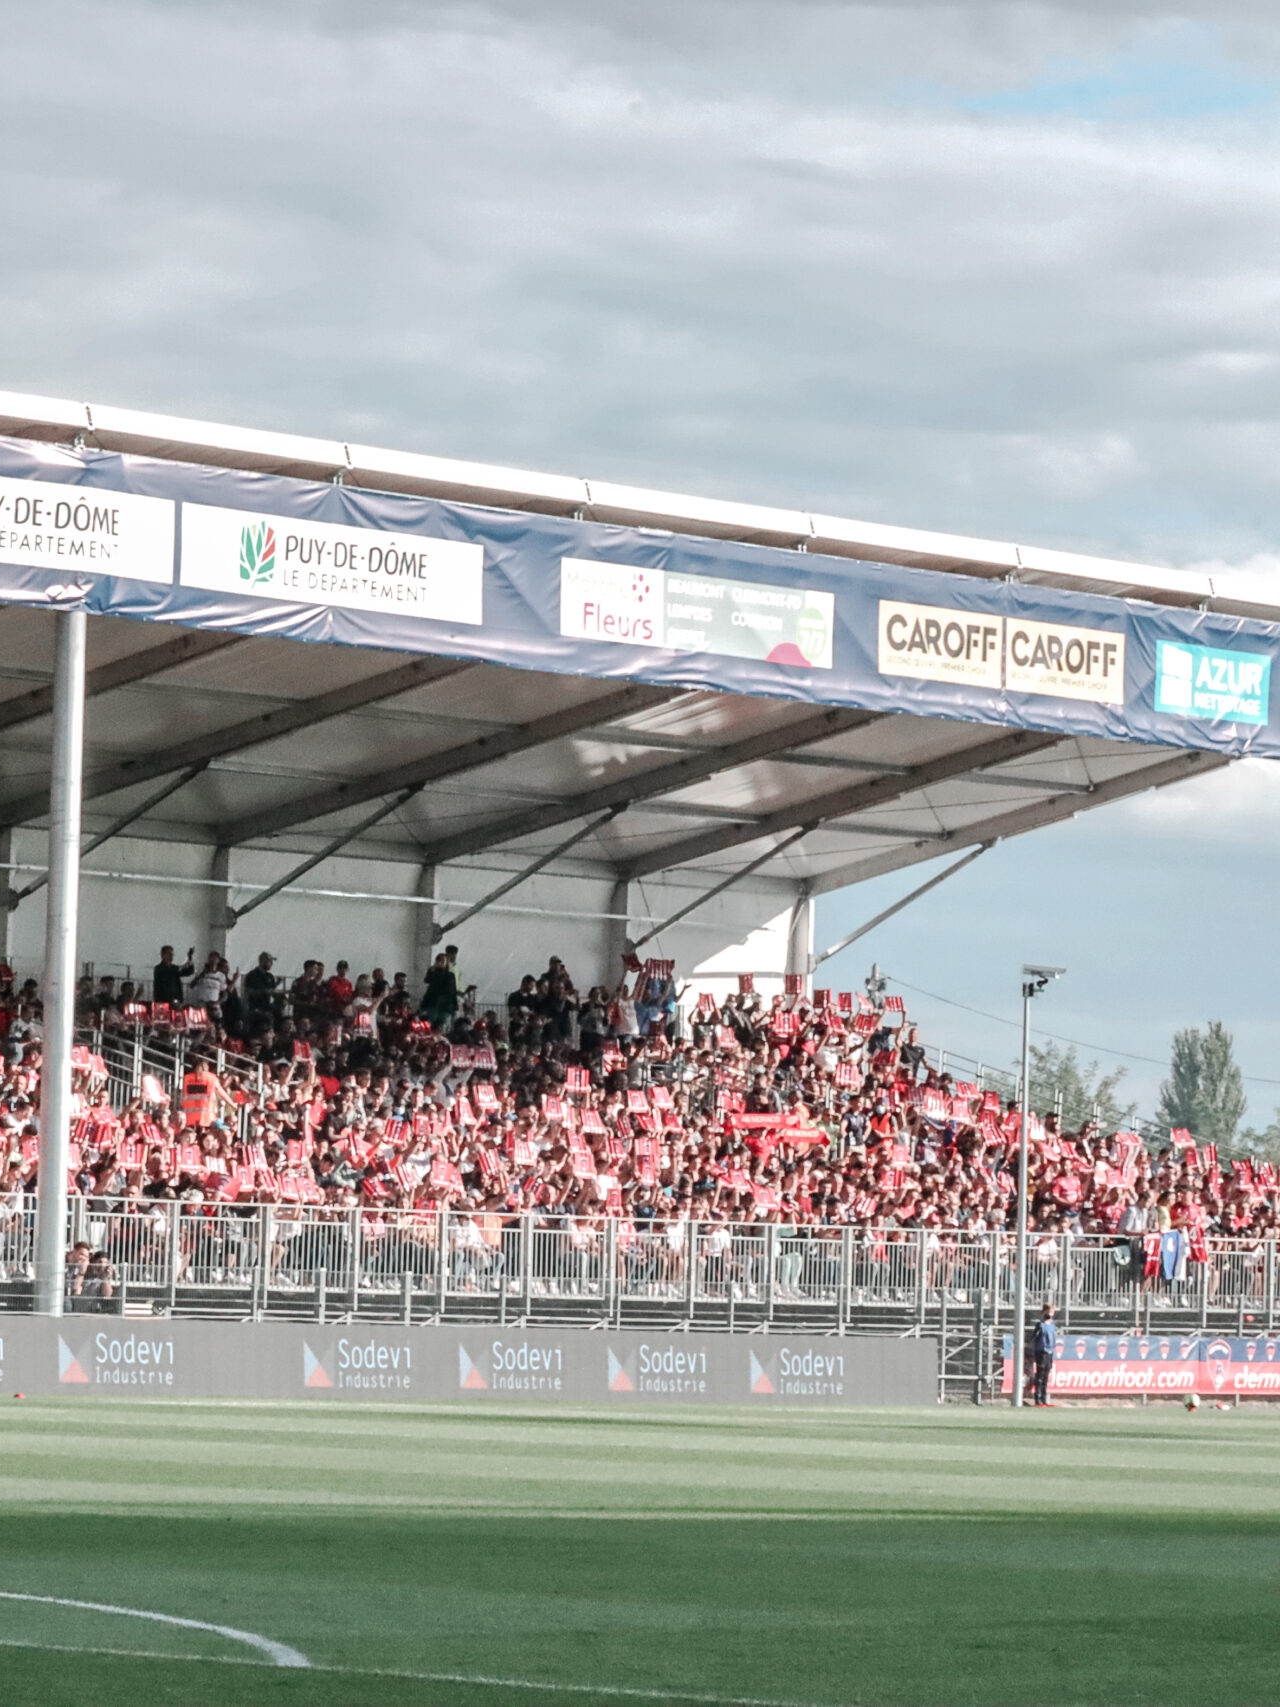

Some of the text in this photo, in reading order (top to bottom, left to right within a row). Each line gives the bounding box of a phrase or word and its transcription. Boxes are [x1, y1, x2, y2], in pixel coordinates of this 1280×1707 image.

[283, 569, 299, 587] LE
[583, 602, 653, 640] Fleurs
[886, 613, 998, 662] CAROFF
[1010, 630, 1118, 678] CAROFF
[1195, 656, 1263, 696] AZUR
[94, 1332, 175, 1366] Sodevi
[337, 1338, 412, 1370] Sodevi
[491, 1341, 563, 1371] Sodevi
[638, 1344, 707, 1375] Sodevi
[779, 1347, 845, 1377] Sodevi
[94, 1366, 175, 1386] Industrie
[338, 1371, 412, 1389] Industrie
[491, 1373, 562, 1391] Industrie
[638, 1375, 707, 1393] Industrie
[779, 1378, 844, 1396] Industrie
[1048, 1362, 1195, 1389] lermontfoot.com
